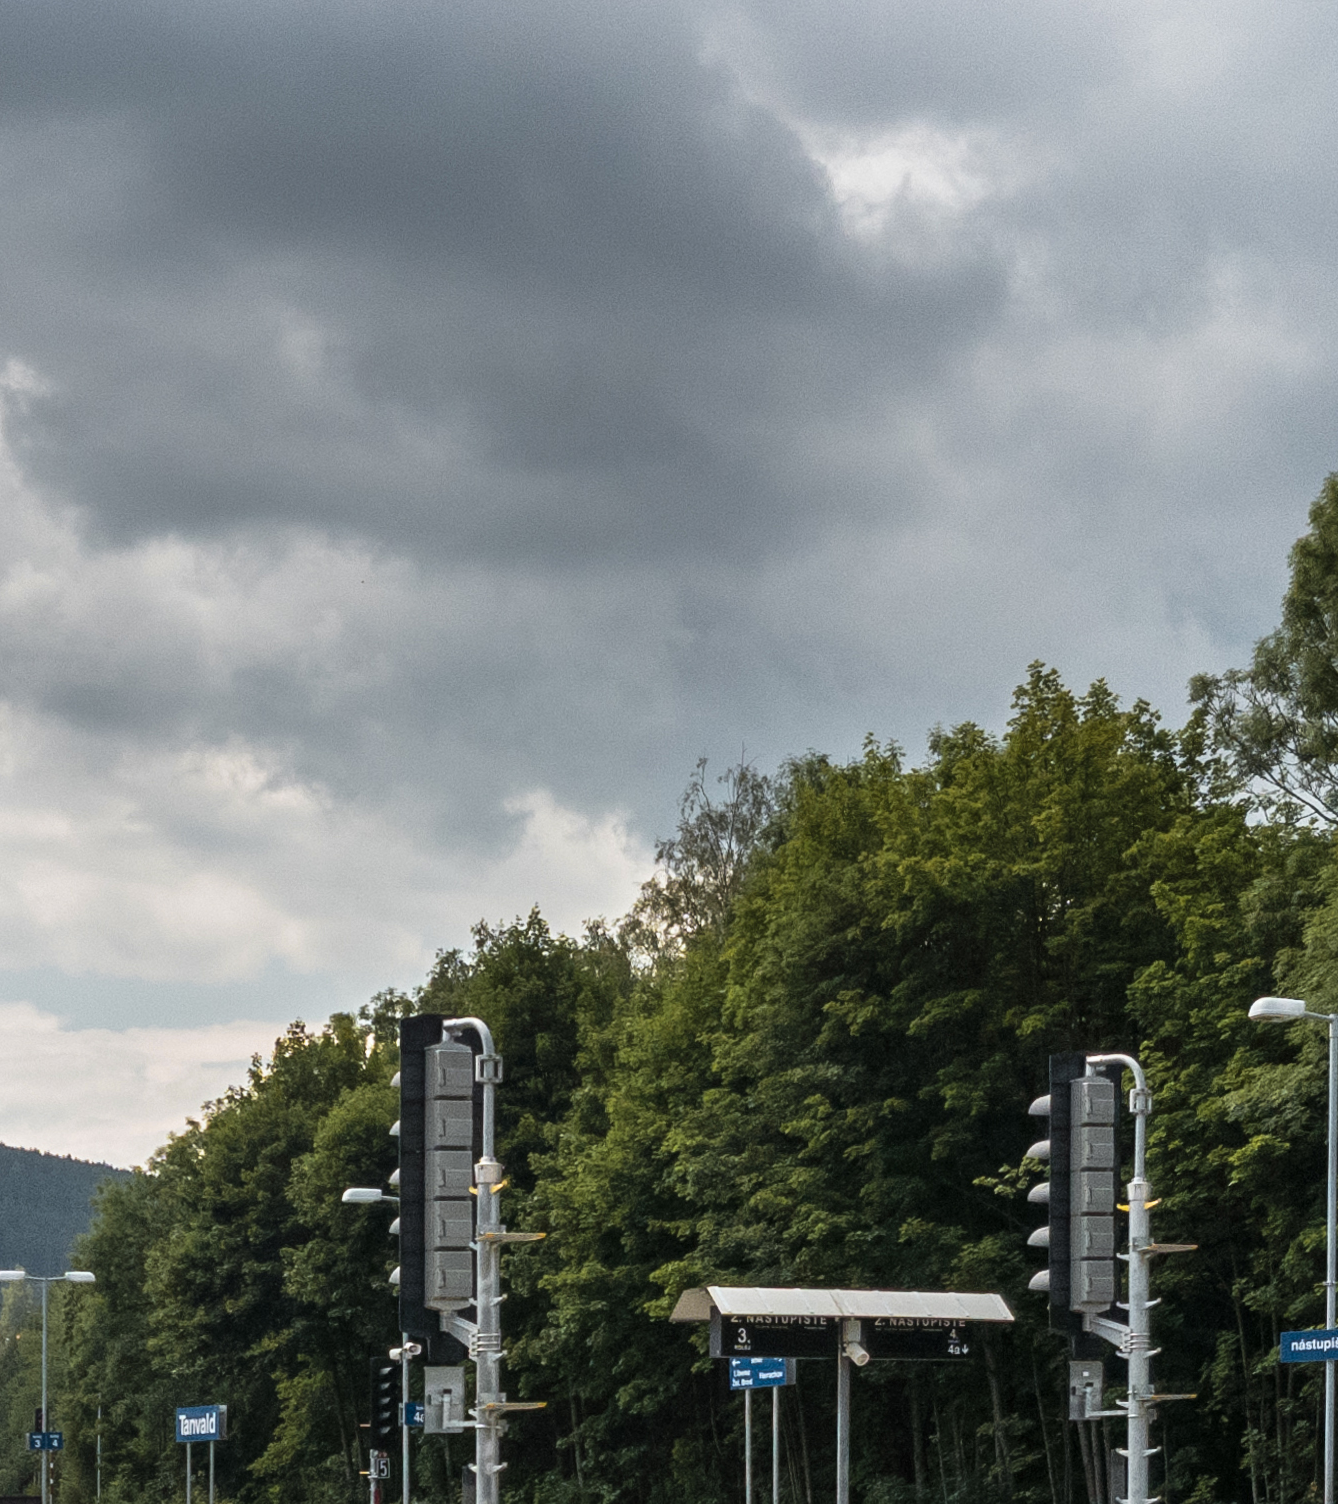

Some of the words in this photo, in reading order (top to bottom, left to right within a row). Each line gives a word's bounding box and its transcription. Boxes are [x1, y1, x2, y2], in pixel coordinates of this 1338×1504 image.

[737, 1327, 751, 1344] 3.
[178, 1411, 216, 1436] Tanvald
[379, 1459, 388, 1477] 5
